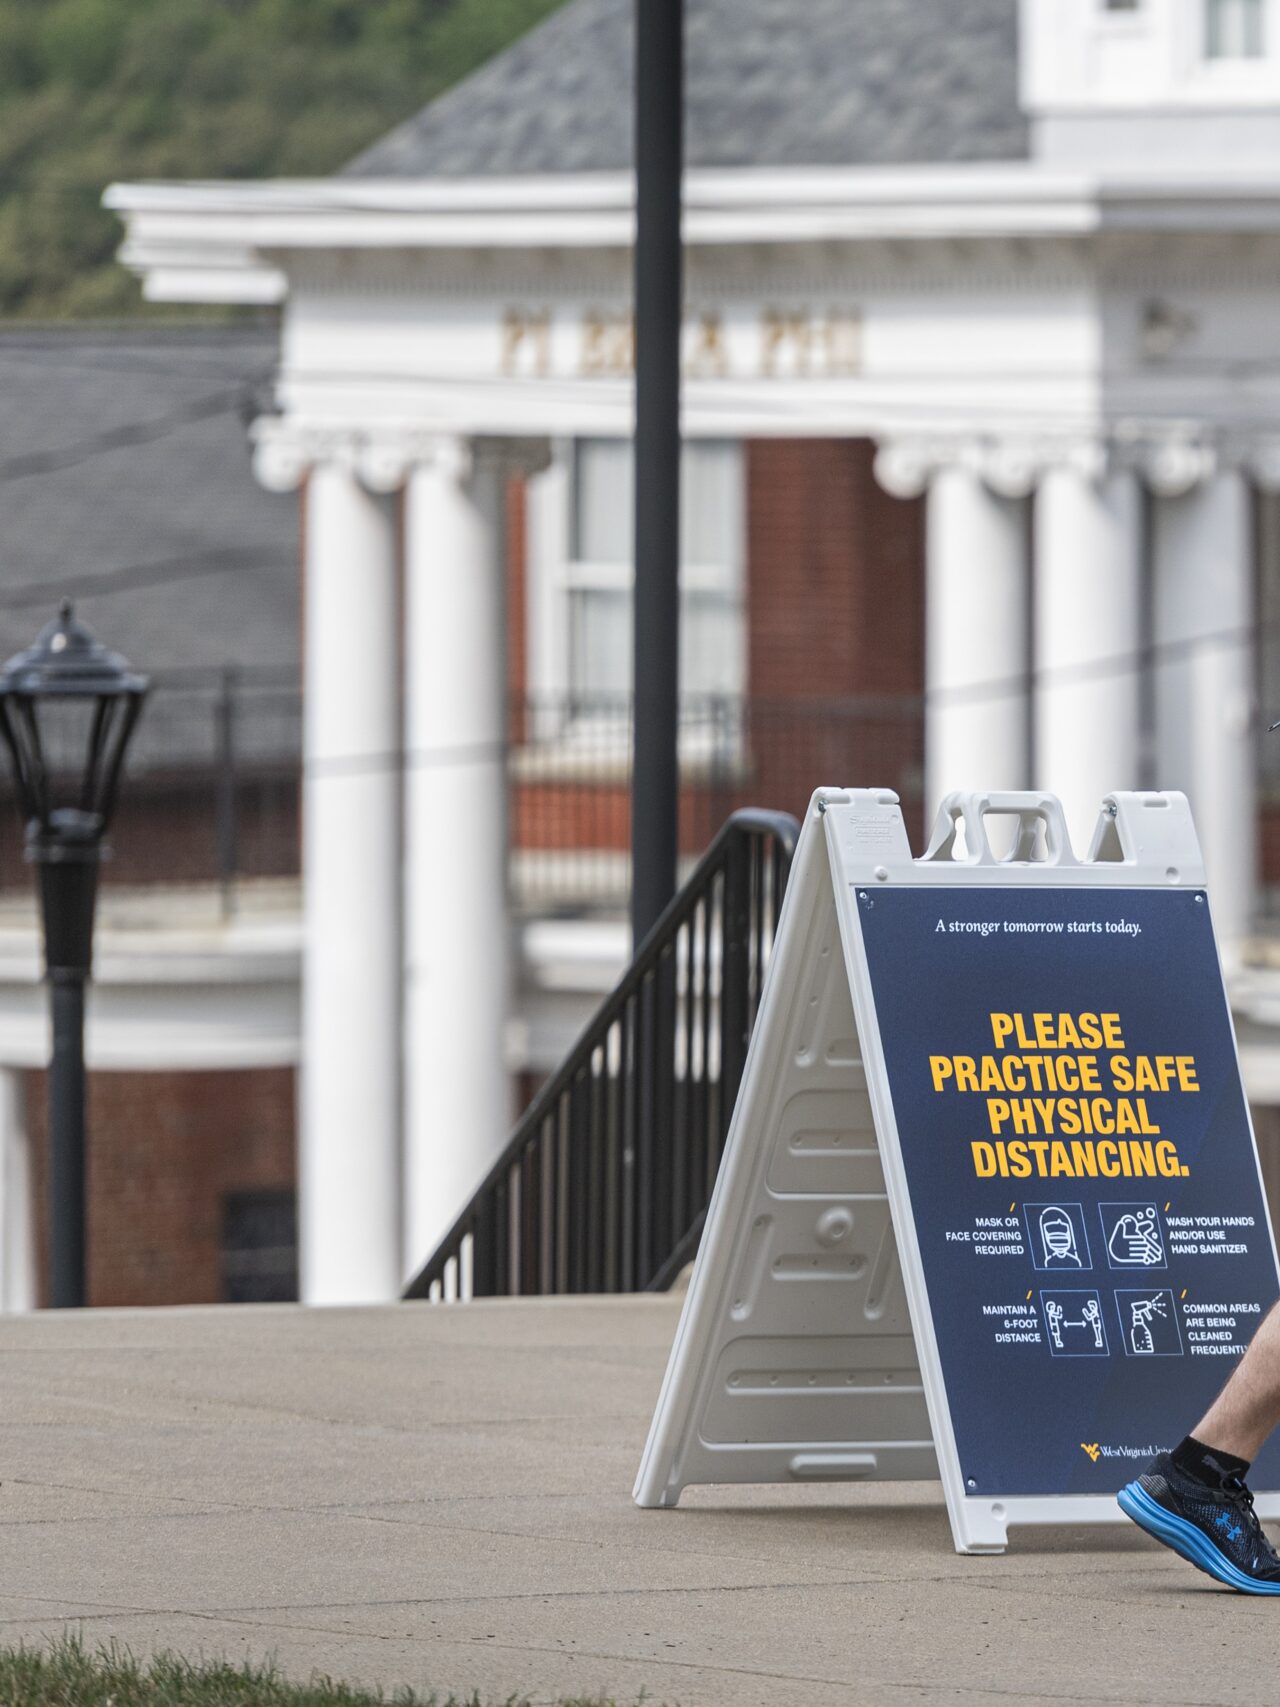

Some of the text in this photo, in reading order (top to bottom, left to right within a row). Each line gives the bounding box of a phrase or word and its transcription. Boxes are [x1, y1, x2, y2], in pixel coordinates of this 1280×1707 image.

[935, 918, 1142, 937] A stronger tomorrow starts today.
[990, 1012, 1126, 1050] PLEASE
[928, 1054, 1200, 1092] PRACTICE SAFE
[986, 1097, 1161, 1135] PHYSICAL
[970, 1140, 1190, 1178] DISTANCING.
[975, 1217, 1020, 1227] MASK OR
[1165, 1216, 1256, 1227] WASH YOUR HANDS
[945, 1231, 1023, 1242] FACE COVERING
[1169, 1230, 1227, 1241] AND/OR USE
[974, 1245, 1025, 1255] REQUIRED
[1170, 1243, 1249, 1254] HAND SANITIZER
[982, 1305, 1037, 1315] MAINTAIN A
[1182, 1303, 1261, 1314] COMMON AREAS
[1003, 1319, 1039, 1329] 6-FOOT
[1185, 1317, 1237, 1328] ARE BEING
[994, 1332, 1042, 1343] DISTANCE
[1187, 1331, 1233, 1342] CLEANED
[1100, 1445, 1120, 1456] West
